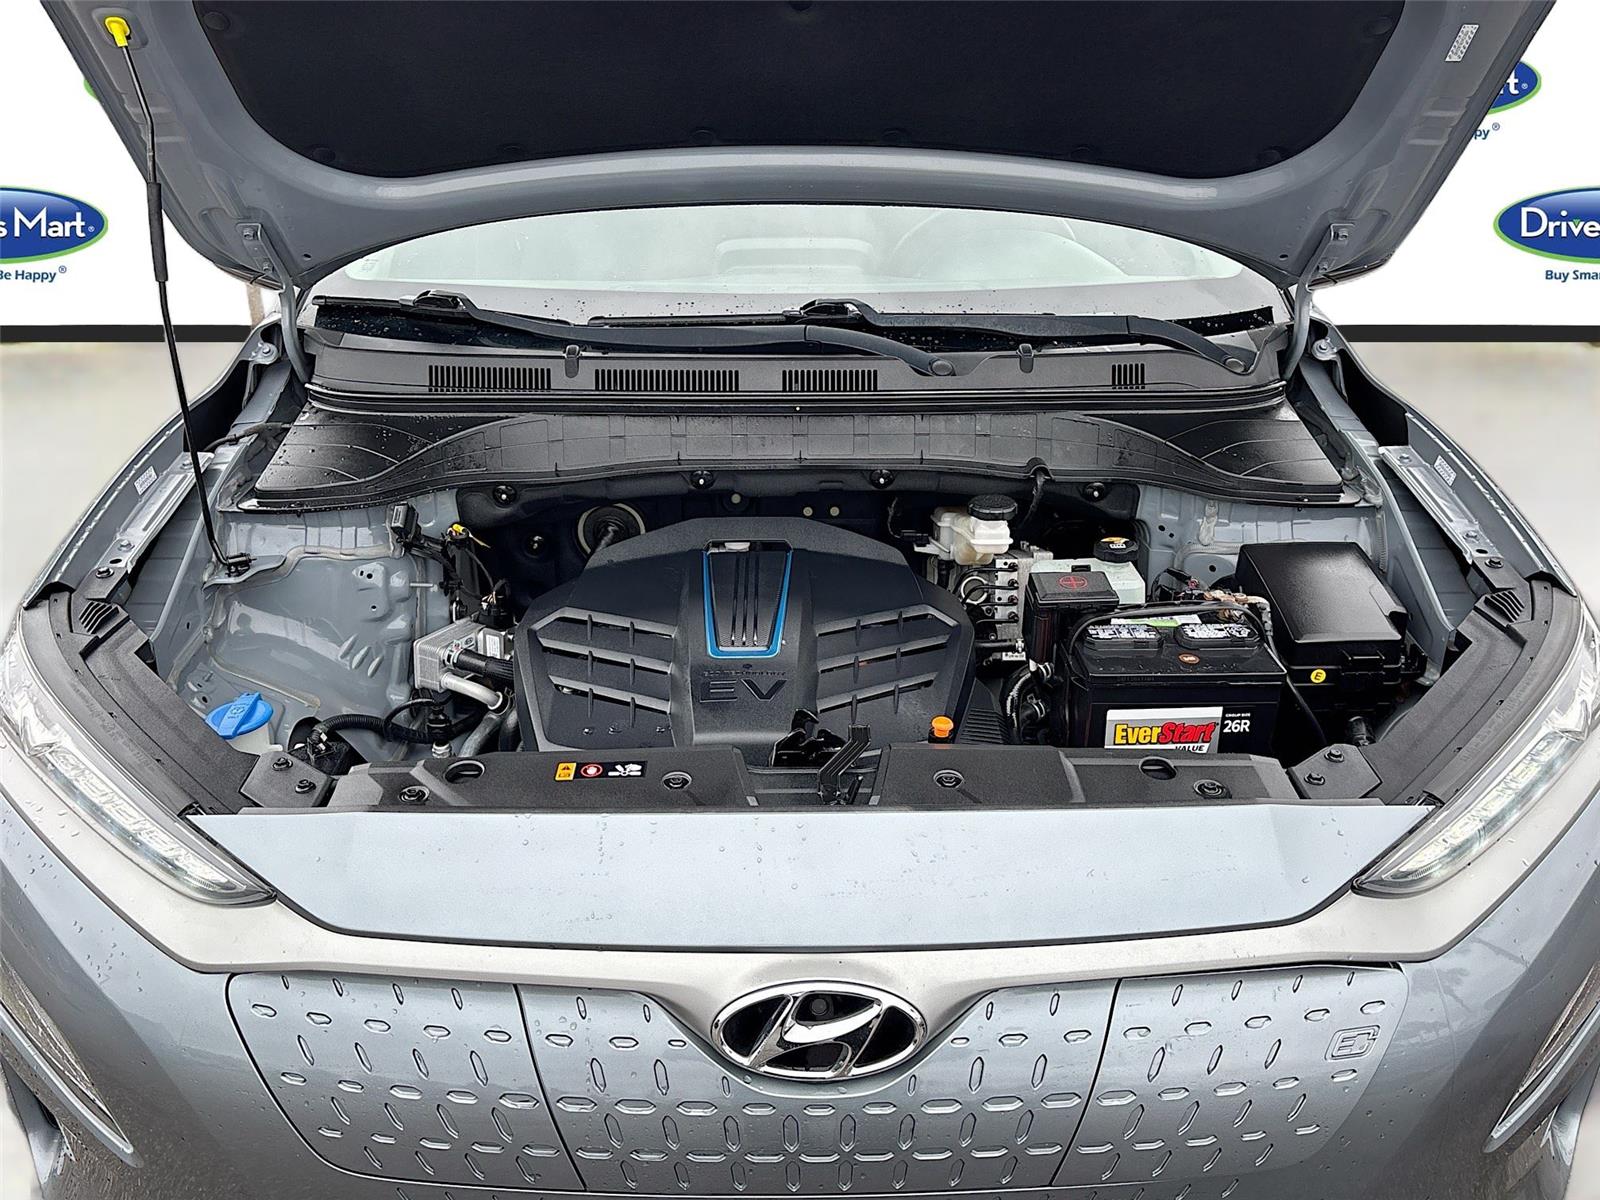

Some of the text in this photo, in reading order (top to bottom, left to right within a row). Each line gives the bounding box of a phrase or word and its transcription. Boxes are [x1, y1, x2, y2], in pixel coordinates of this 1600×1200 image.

[14, 206, 86, 238] Mart
[15, 269, 57, 283] Happy
[1545, 269, 1600, 283] Buy Sma
[699, 678, 788, 702] EV
[1114, 721, 1217, 746] EverStart
[1222, 719, 1251, 733] 26R
